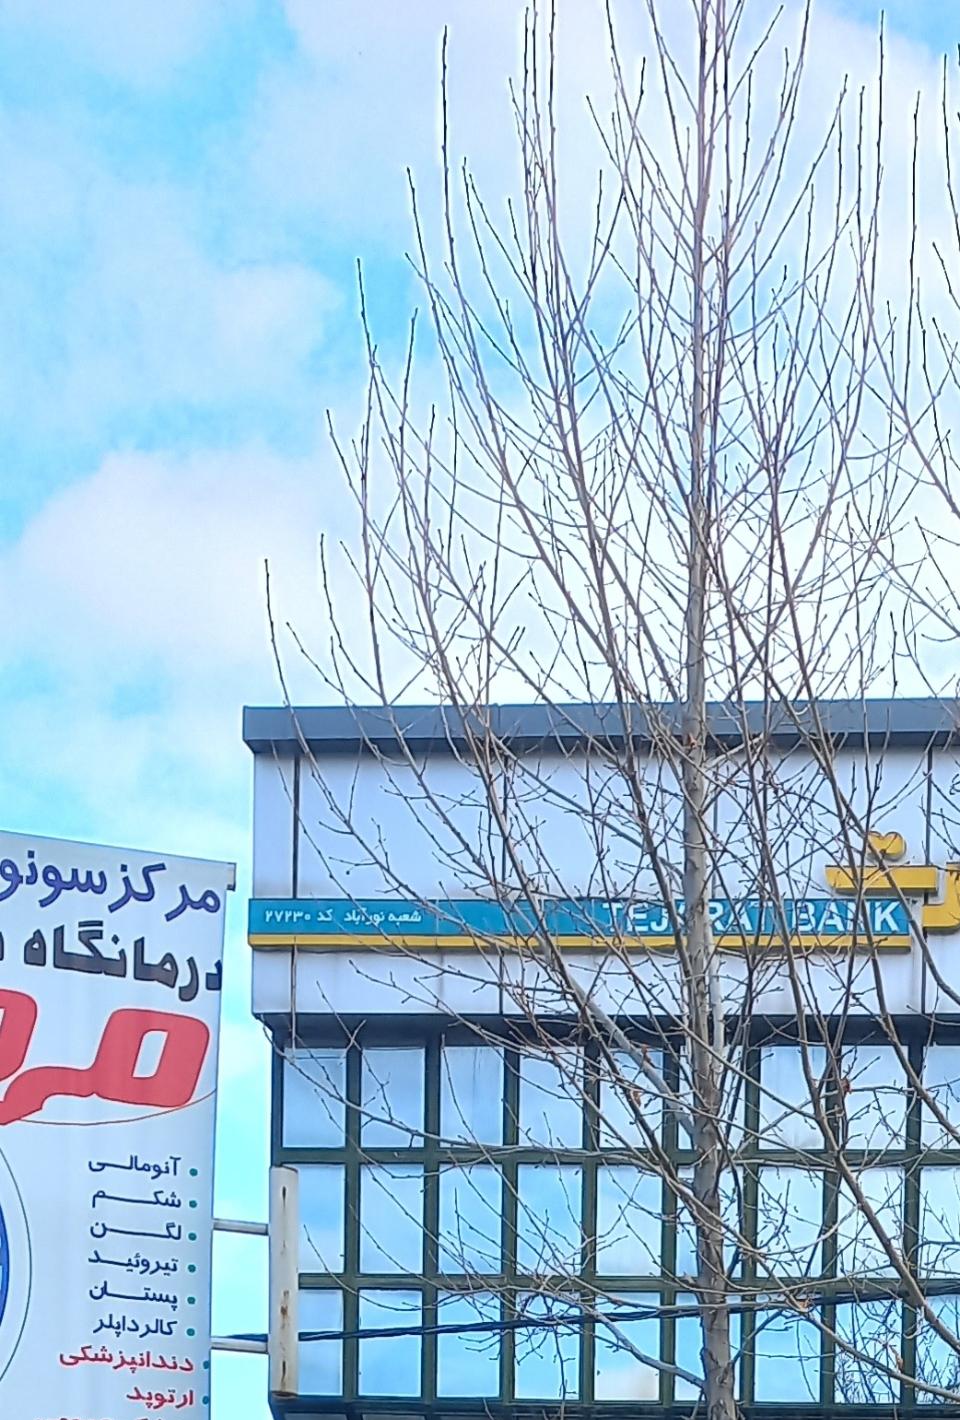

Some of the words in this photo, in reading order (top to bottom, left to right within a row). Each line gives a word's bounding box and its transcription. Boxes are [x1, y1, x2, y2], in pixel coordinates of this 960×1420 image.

[108, 862, 221, 922] مرکز
[316, 908, 334, 922] کد
[343, 907, 385, 925] نورآباد
[387, 910, 422, 924] شعبه
[88, 1155, 182, 1180] آنومالی
[92, 1189, 182, 1209] شکم
[90, 1221, 182, 1241] لگن
[88, 1250, 179, 1276] تیروئید
[89, 1280, 178, 1312] پستان
[92, 1313, 178, 1338] کالرداپلر
[59, 1345, 194, 1373] دندانپزشکی
[126, 1386, 194, 1409] ارتوپد
